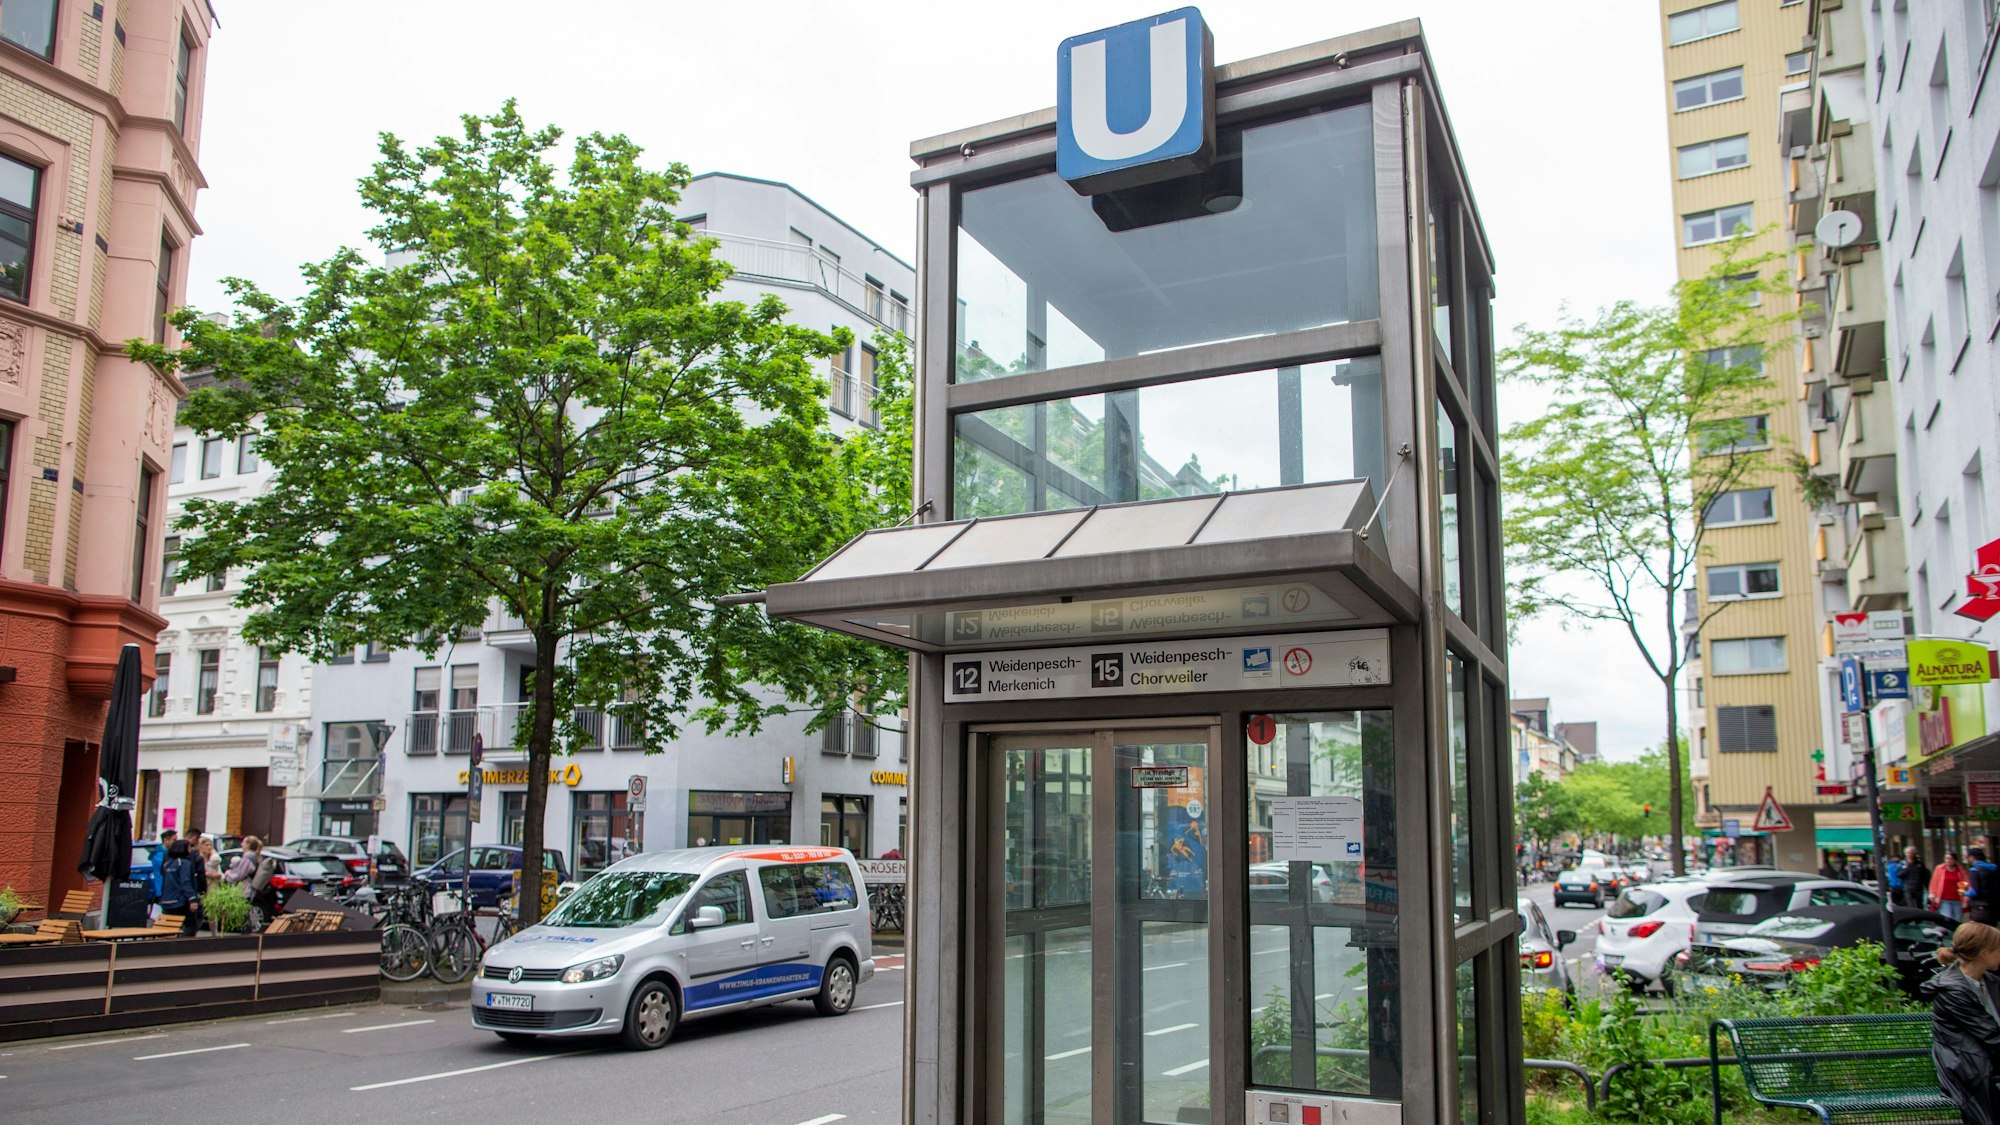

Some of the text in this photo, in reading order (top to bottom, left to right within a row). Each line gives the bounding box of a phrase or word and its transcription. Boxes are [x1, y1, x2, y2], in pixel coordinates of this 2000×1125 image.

[1071, 17, 1188, 161] U
[989, 656, 1082, 672] Weidenpesch-
[1130, 648, 1232, 665] Weidenpesch-
[1094, 659, 1120, 682] 15
[1916, 660, 1985, 676] ALNATURA
[955, 667, 979, 689] 12
[988, 678, 1055, 692] Merkenich
[1130, 670, 1208, 685] Chorweiler
[1255, 720, 1265, 740] 1
